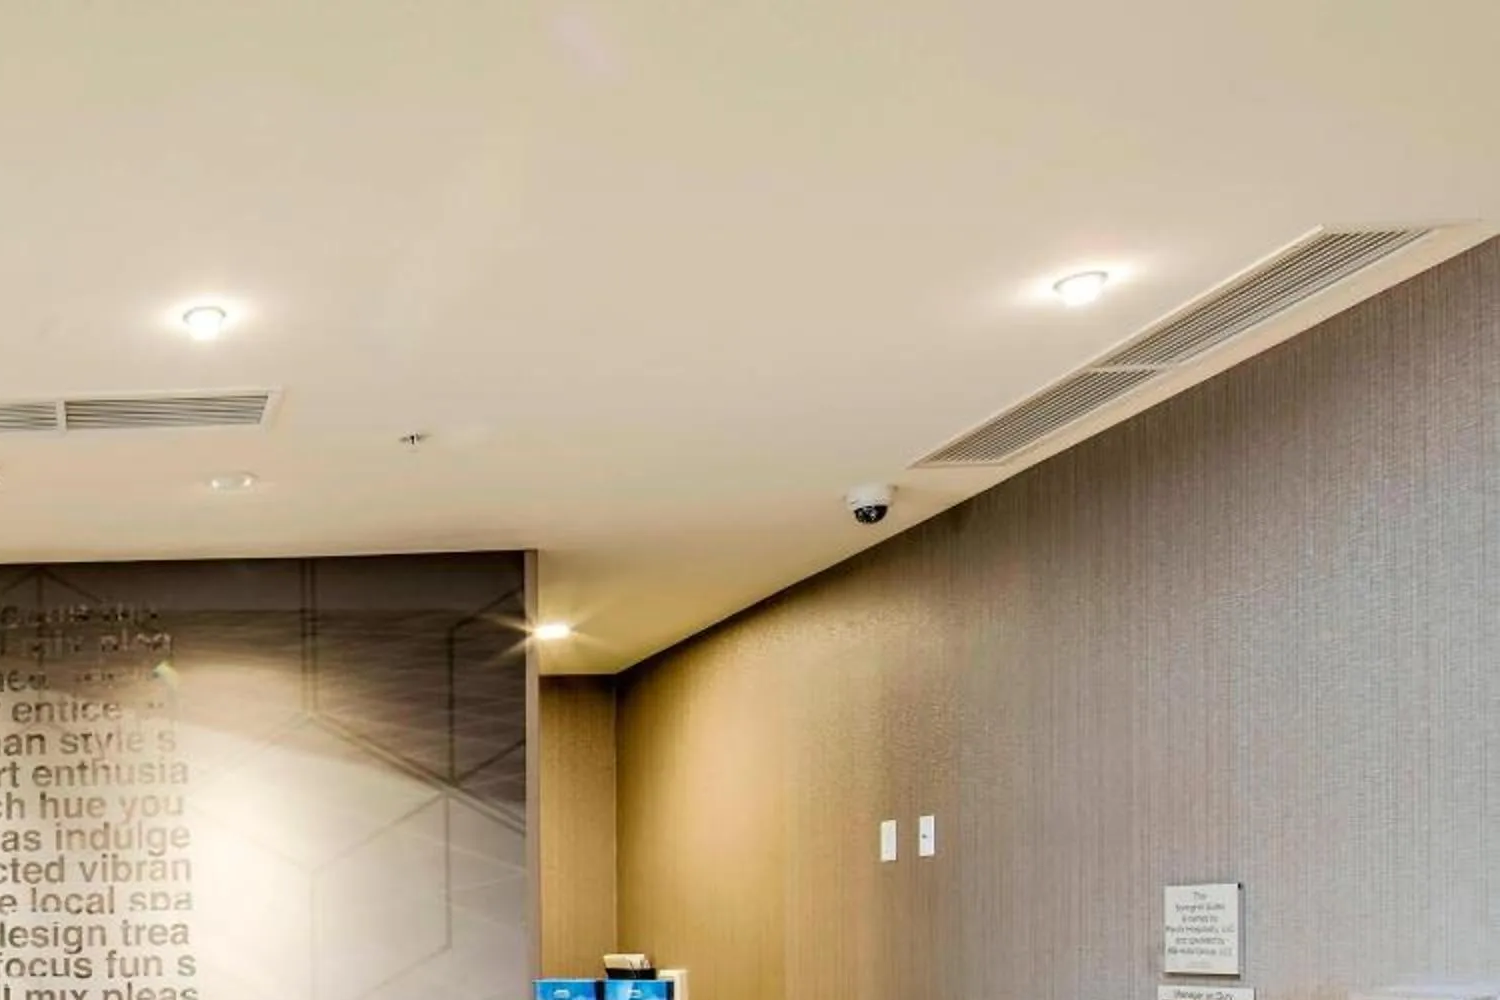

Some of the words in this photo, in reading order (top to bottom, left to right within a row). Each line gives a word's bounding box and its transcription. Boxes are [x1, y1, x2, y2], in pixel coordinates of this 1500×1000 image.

[11, 700, 122, 724] entice
[59, 727, 145, 760] style
[31, 757, 189, 787] enthusia
[39, 792, 106, 819] hue
[120, 793, 184, 824] you
[56, 822, 191, 856] indulge
[79, 854, 193, 884] vibran
[31, 887, 115, 915] local
[121, 919, 190, 946] trea
[106, 951, 163, 979] fun
[177, 953, 197, 978] s
